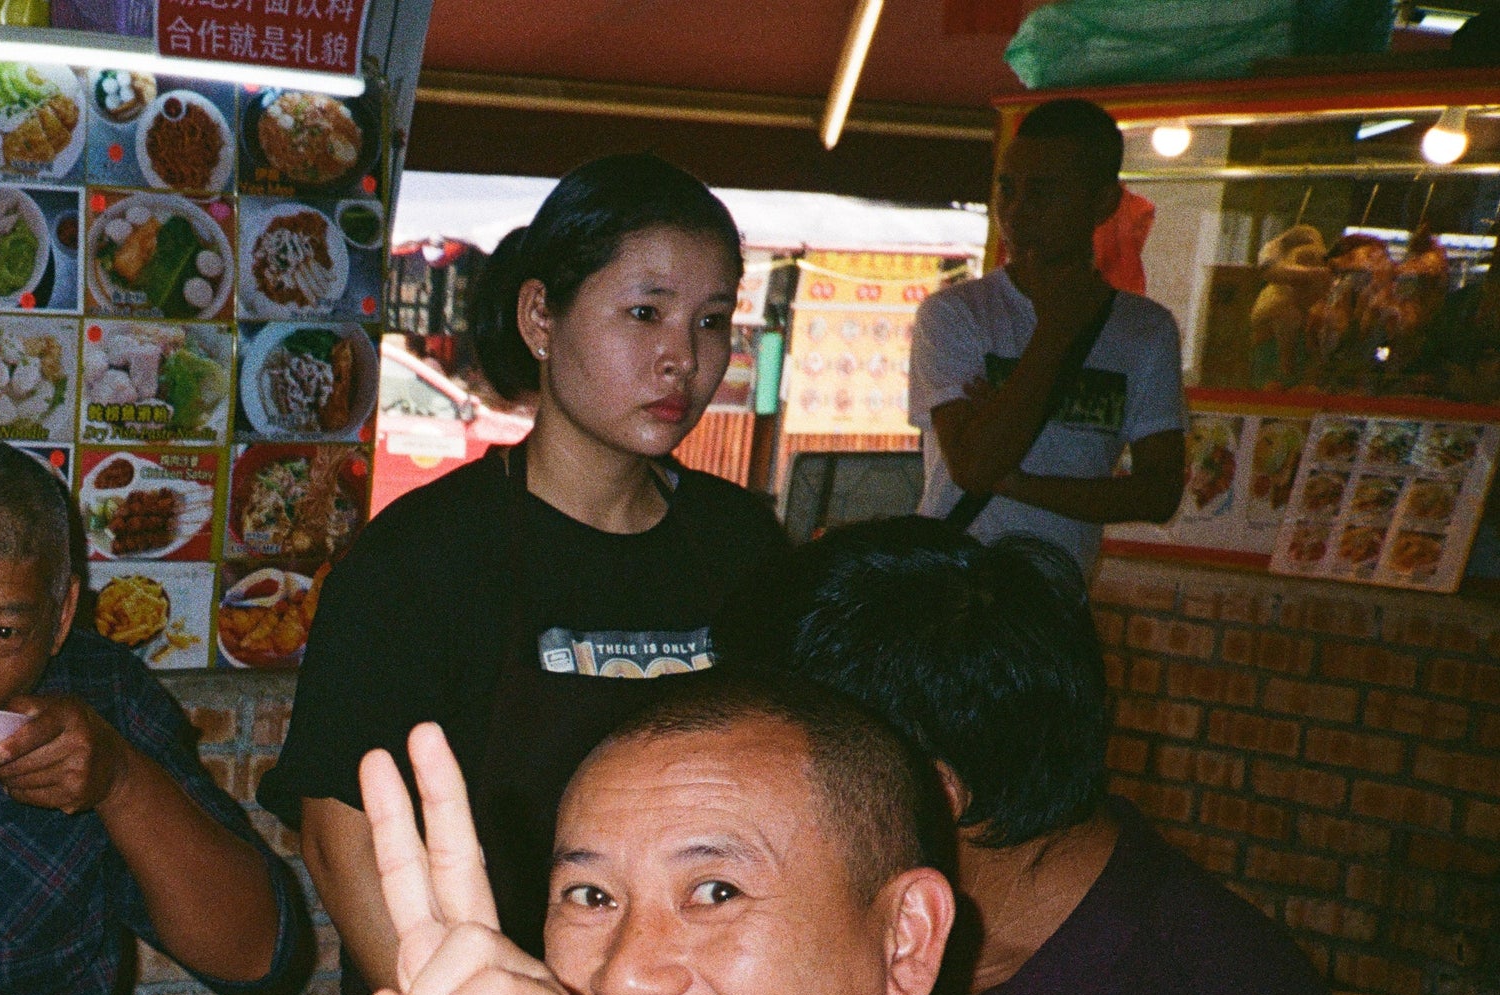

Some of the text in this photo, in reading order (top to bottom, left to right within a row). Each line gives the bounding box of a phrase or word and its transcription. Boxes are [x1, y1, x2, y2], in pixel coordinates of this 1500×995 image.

[165, 15, 350, 67] 合作就是礼貌
[0, 425, 50, 440] Noodle
[597, 642, 696, 655] THERE IS ONLY
